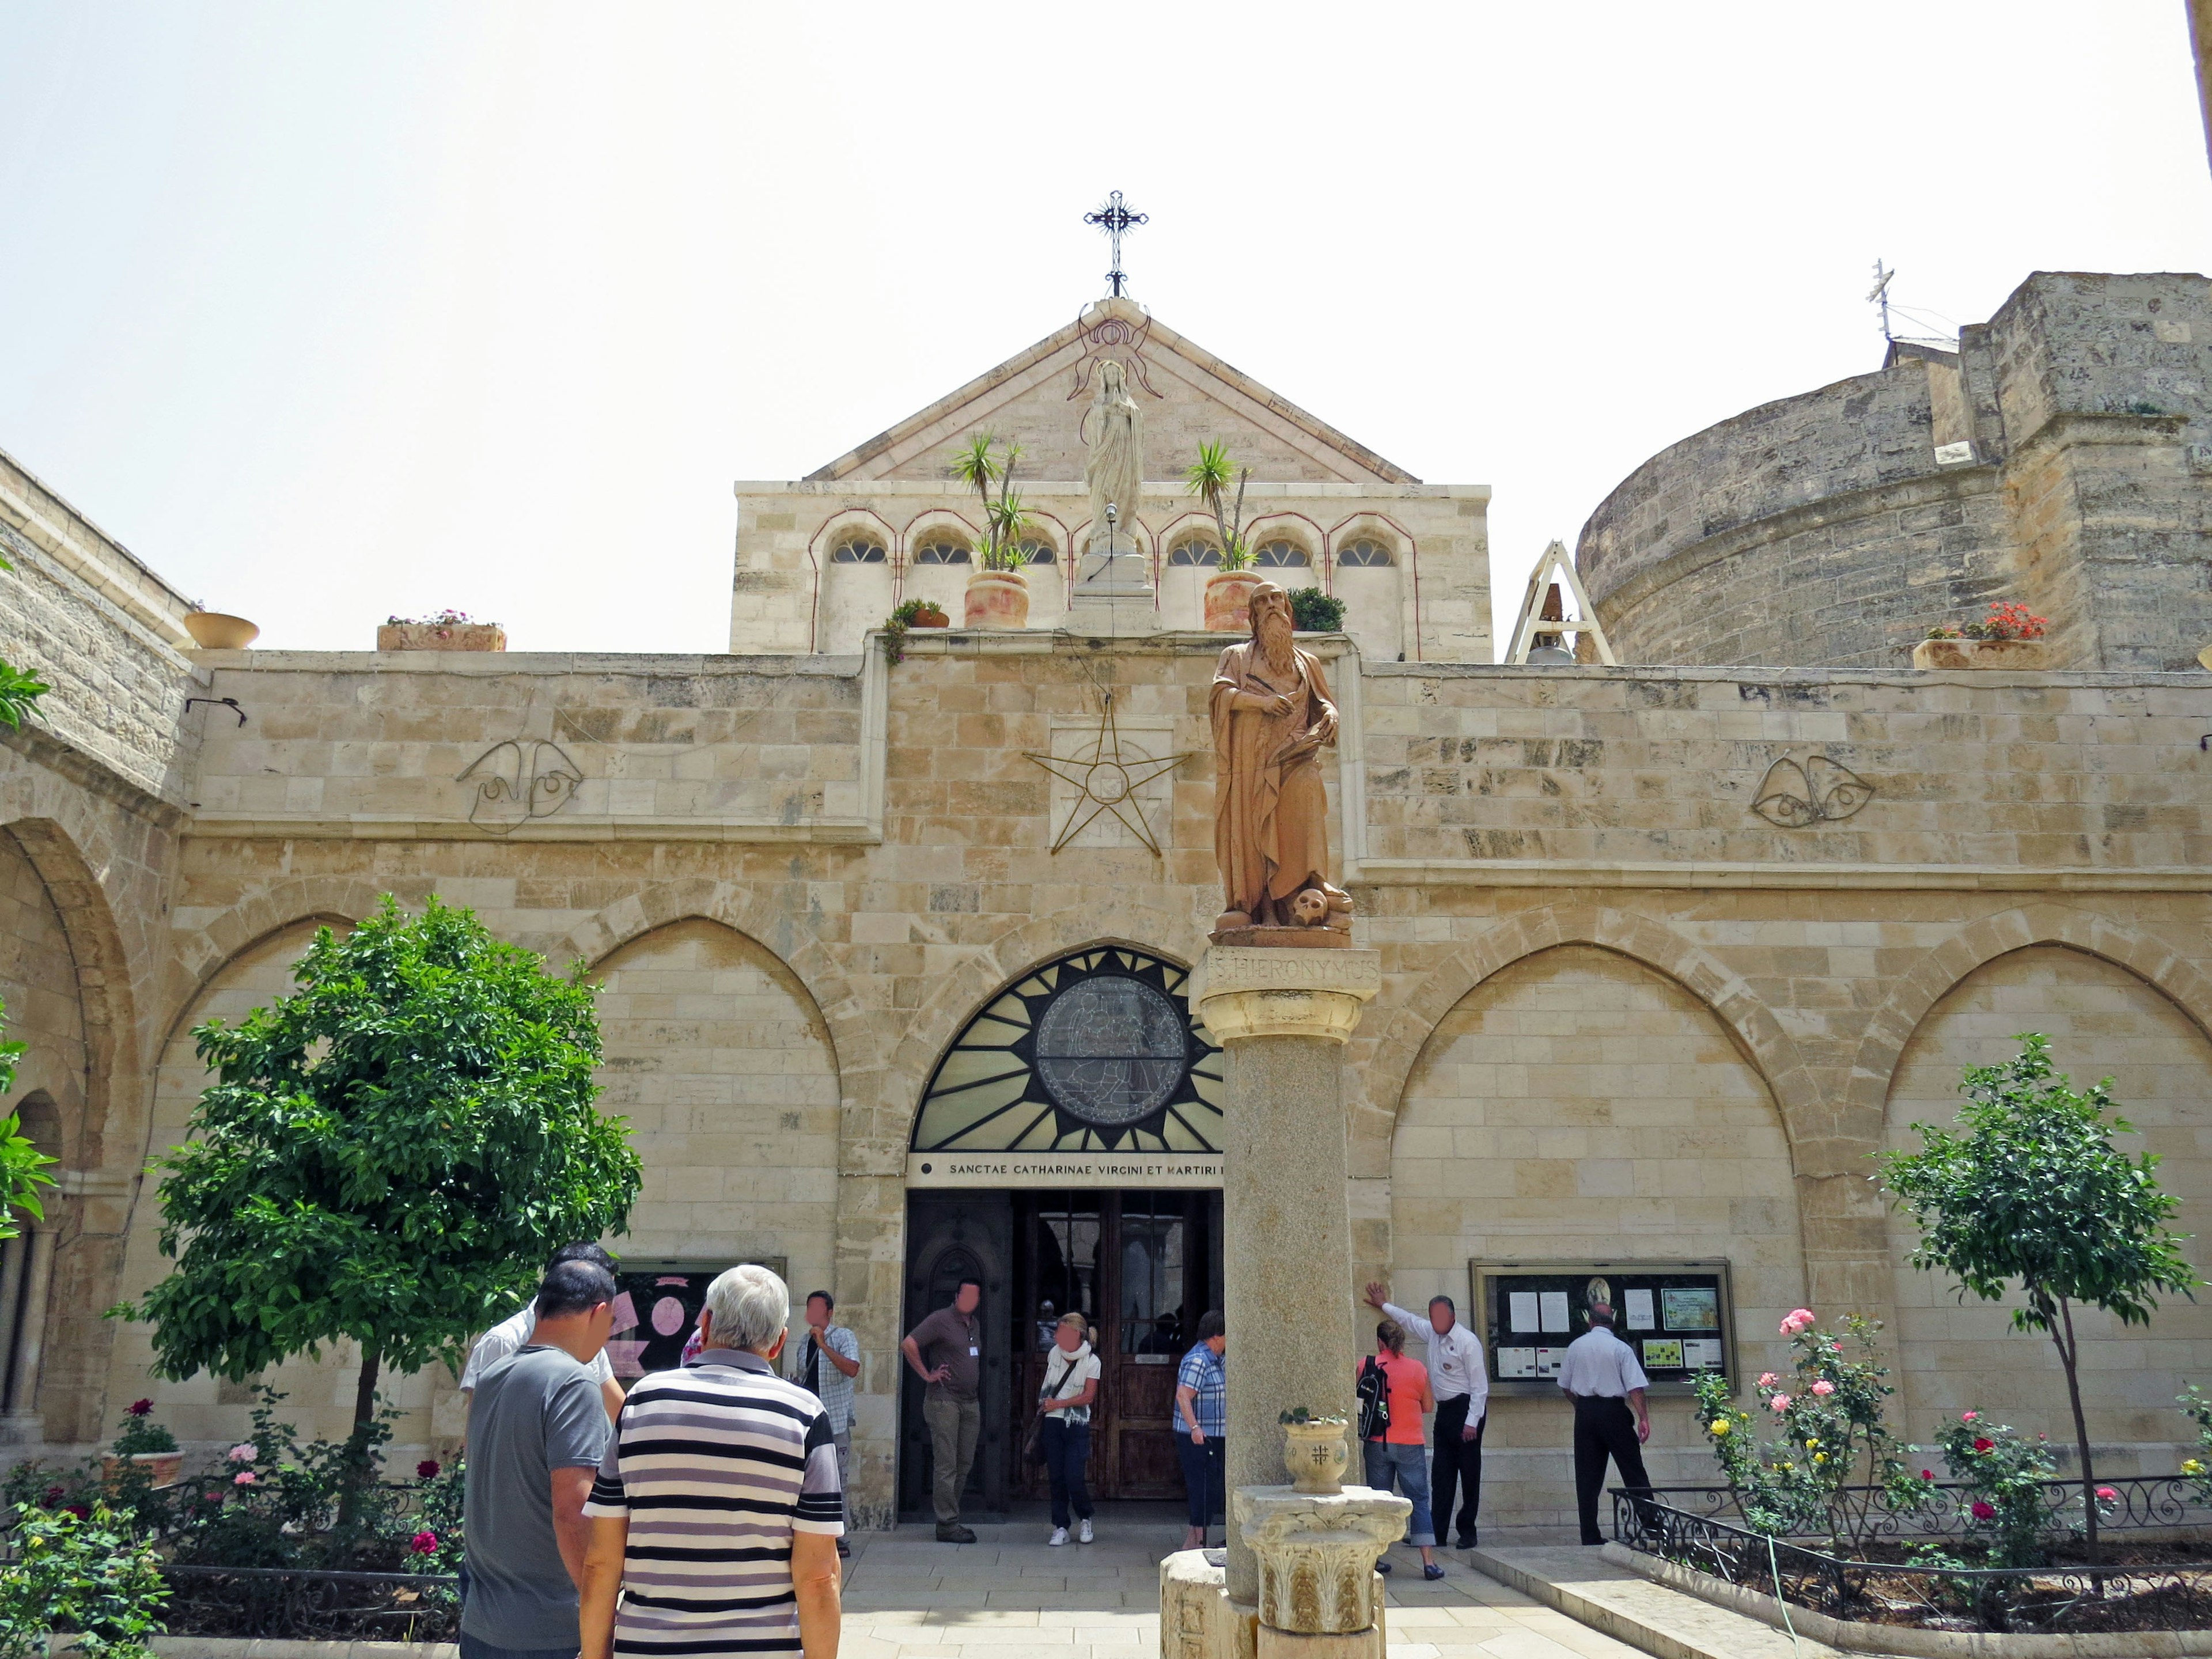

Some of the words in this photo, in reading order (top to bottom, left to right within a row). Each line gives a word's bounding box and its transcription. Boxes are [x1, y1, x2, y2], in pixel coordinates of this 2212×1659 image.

[1234, 958, 1378, 979] HIERONYMUS
[950, 1165, 1007, 1174] SANCTAE
[1014, 1165, 1092, 1174] CATHARINAE
[1098, 1165, 1142, 1175] VIRGINI
[1147, 1165, 1162, 1175] ET
[1167, 1165, 1216, 1175] MARTIRI
